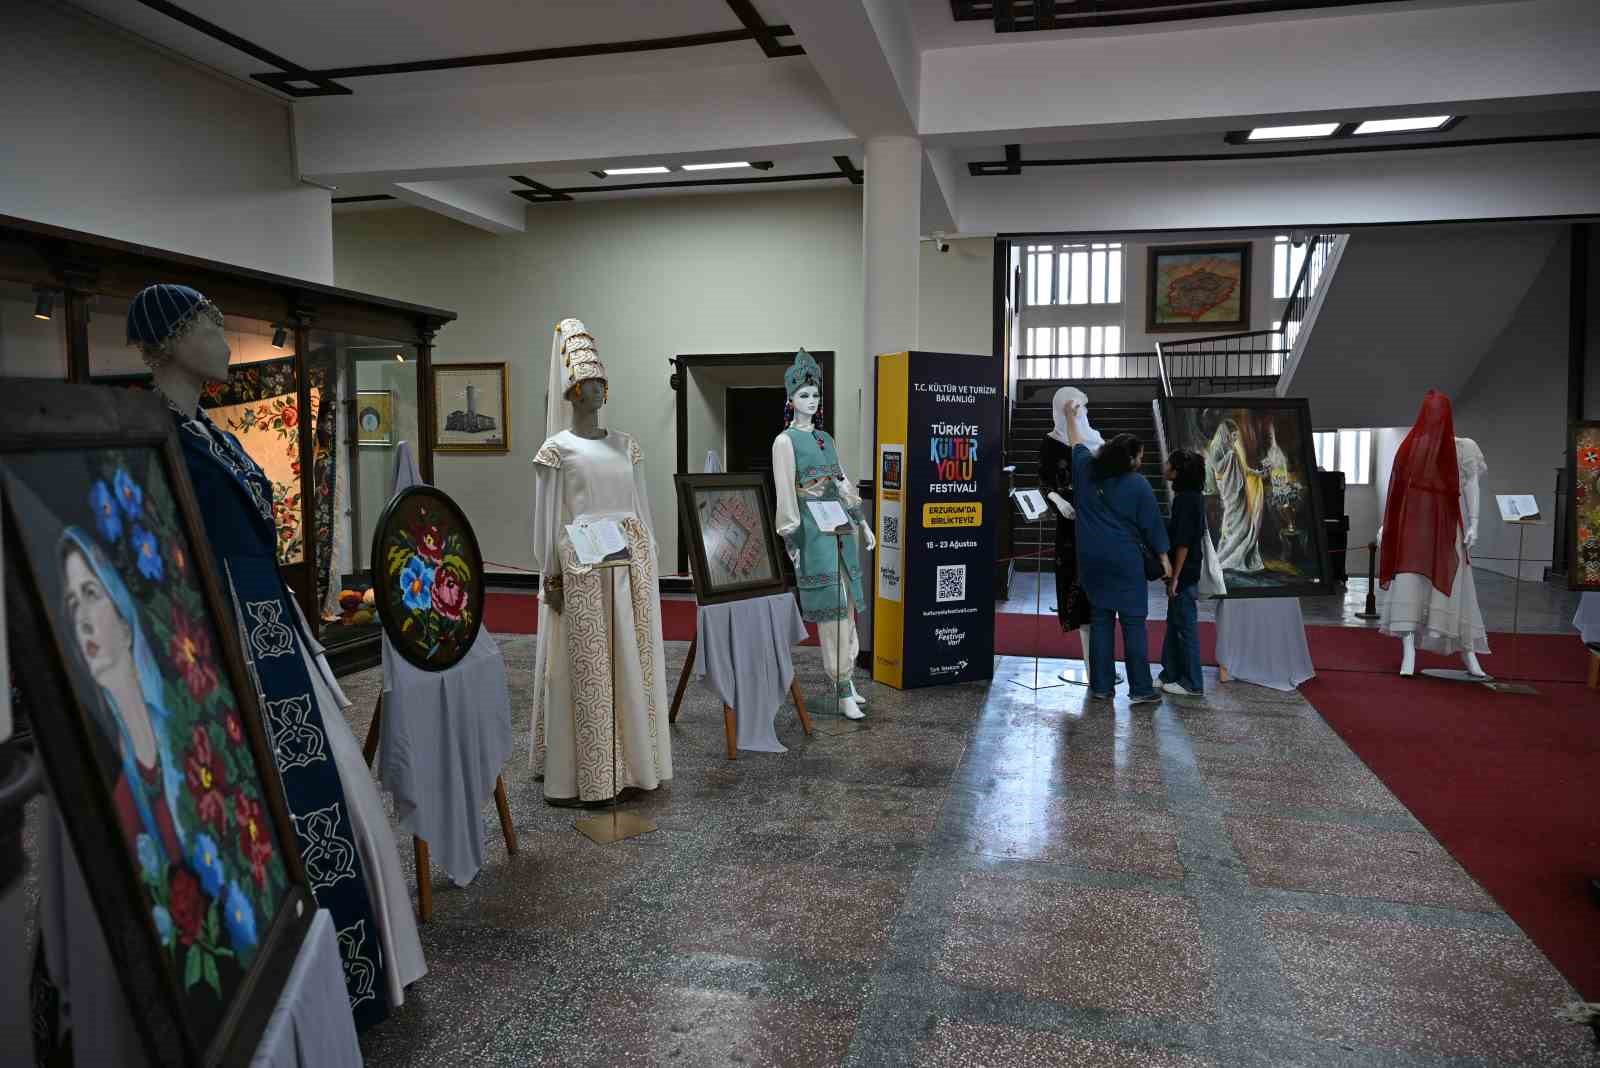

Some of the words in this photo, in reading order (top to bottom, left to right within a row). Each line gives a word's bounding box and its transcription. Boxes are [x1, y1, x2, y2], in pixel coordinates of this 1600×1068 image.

[928, 382, 957, 393] KÜLTÜR
[958, 385, 968, 393] VE
[969, 385, 996, 394] TURİZM
[936, 394, 976, 403] BAKANLIĞI
[931, 422, 978, 436] TÜRKİYE
[930, 437, 978, 463] KÜLTÜR
[937, 458, 974, 481] YOLU
[929, 481, 977, 493] FESTİVALİ
[929, 505, 977, 514] ERZURUM'DA
[949, 540, 978, 550] Ağustos
